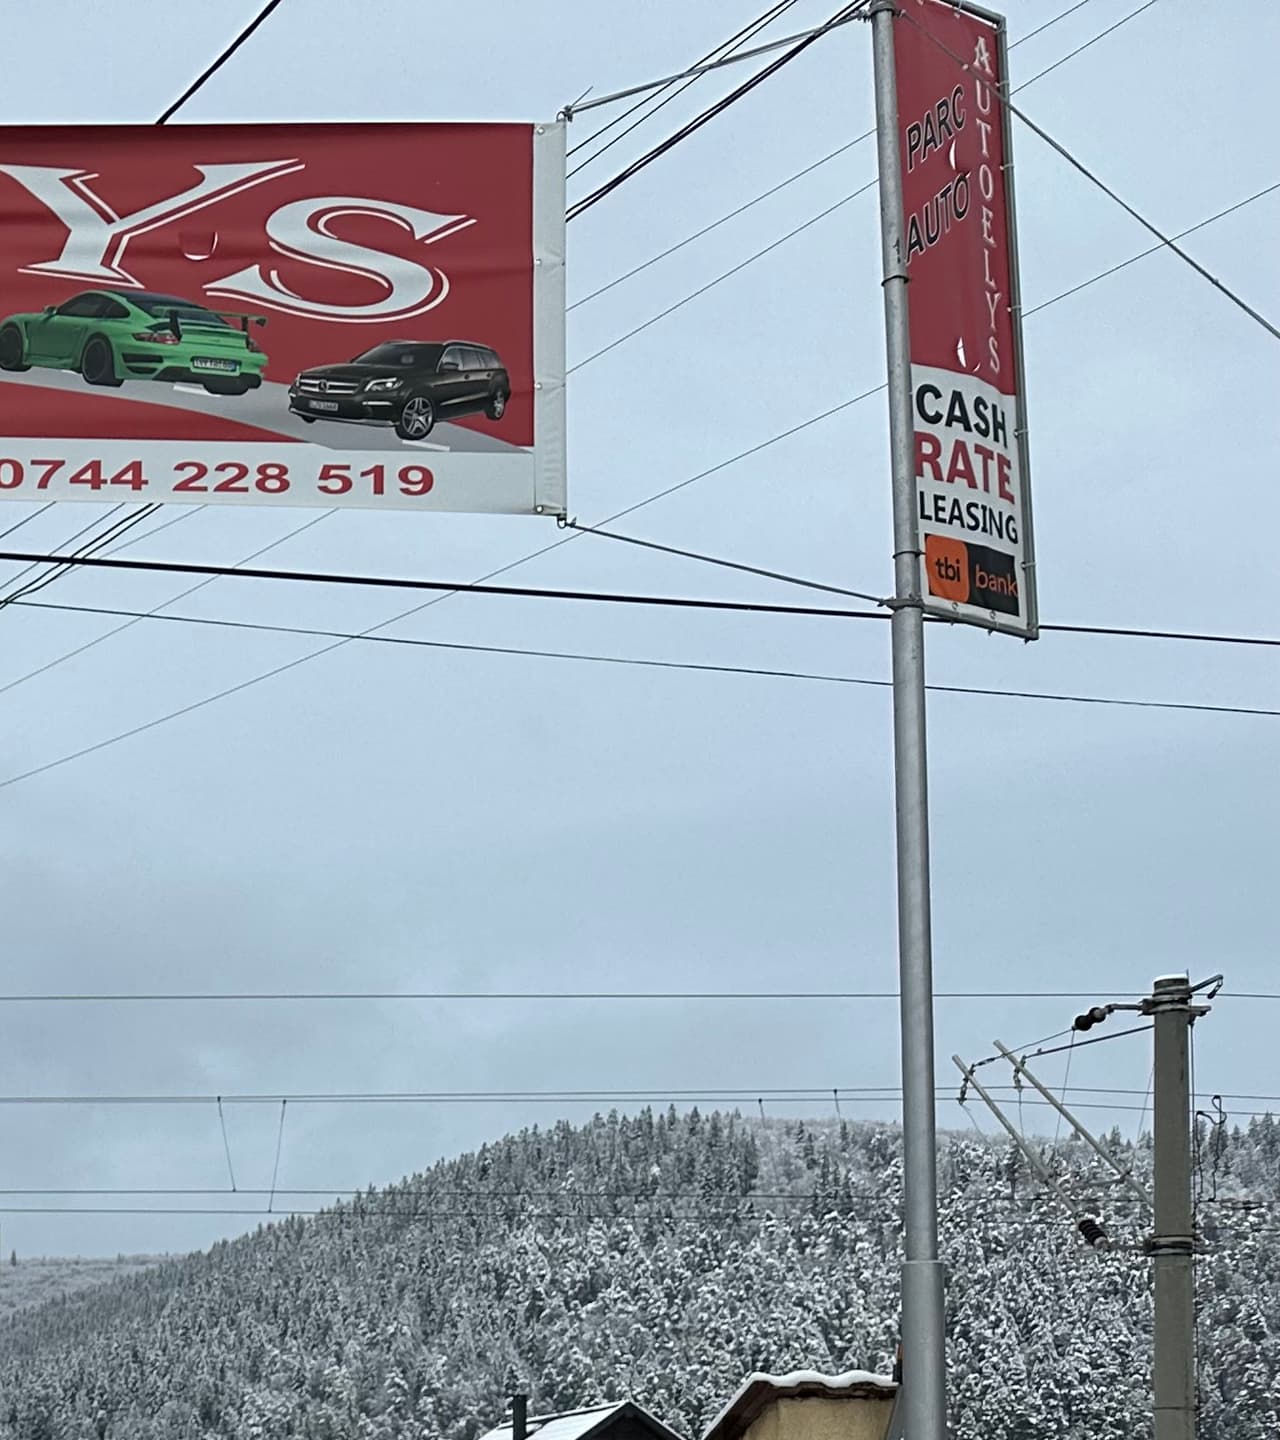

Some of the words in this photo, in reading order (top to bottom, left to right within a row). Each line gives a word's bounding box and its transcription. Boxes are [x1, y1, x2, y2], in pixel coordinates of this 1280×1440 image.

[906, 84, 967, 173] PARC
[905, 173, 970, 266] AUTO
[973, 36, 1003, 375] AUTOELYS
[916, 384, 1008, 449] CASH
[172, 461, 291, 495] 228
[316, 465, 435, 497] 519
[914, 430, 1015, 505] RATE
[919, 490, 1019, 545] LEASING
[936, 556, 961, 583] tbi
[975, 565, 1018, 597] bank
